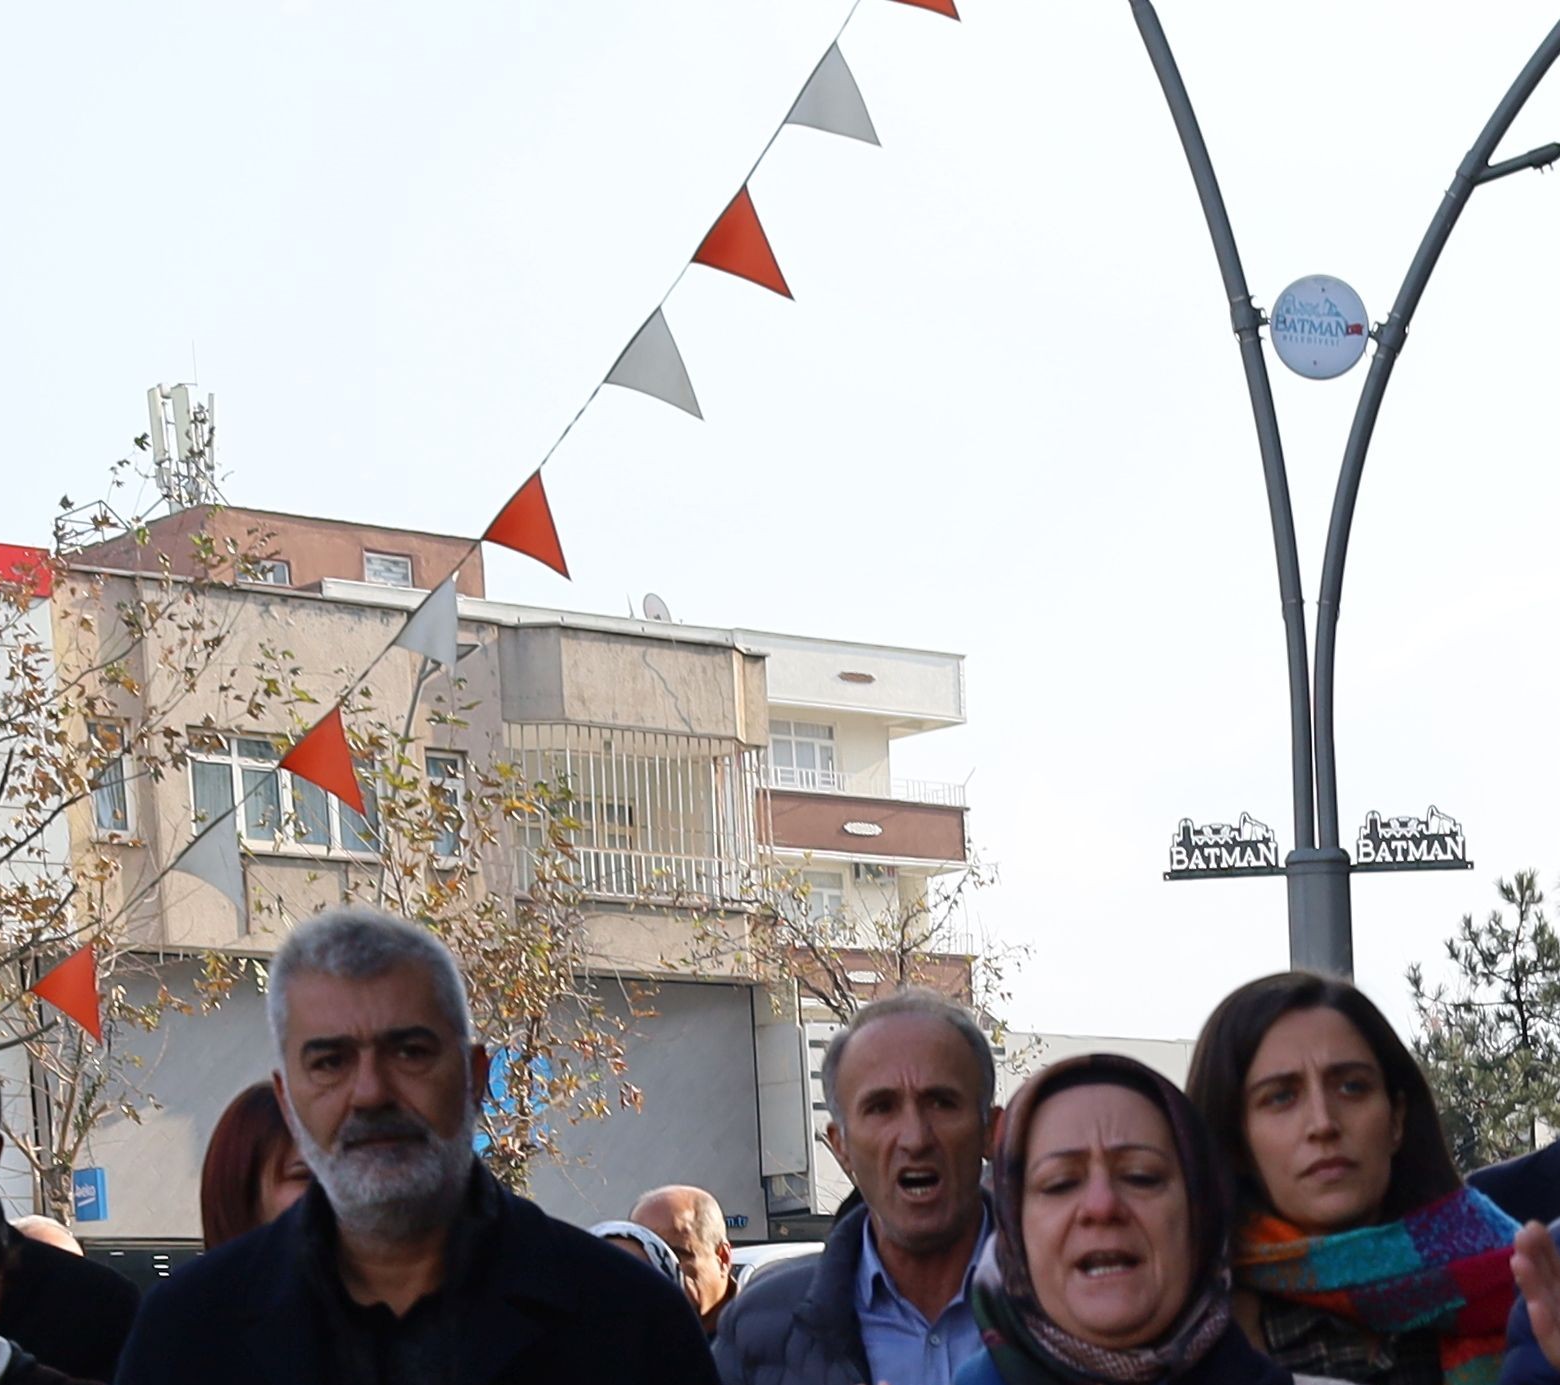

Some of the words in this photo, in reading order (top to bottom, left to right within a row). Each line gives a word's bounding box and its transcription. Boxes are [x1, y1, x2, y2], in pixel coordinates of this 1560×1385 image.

[1274, 314, 1348, 338] BATMAN
[1171, 842, 1277, 870] BATMAN
[1357, 837, 1465, 863] BATMAN
